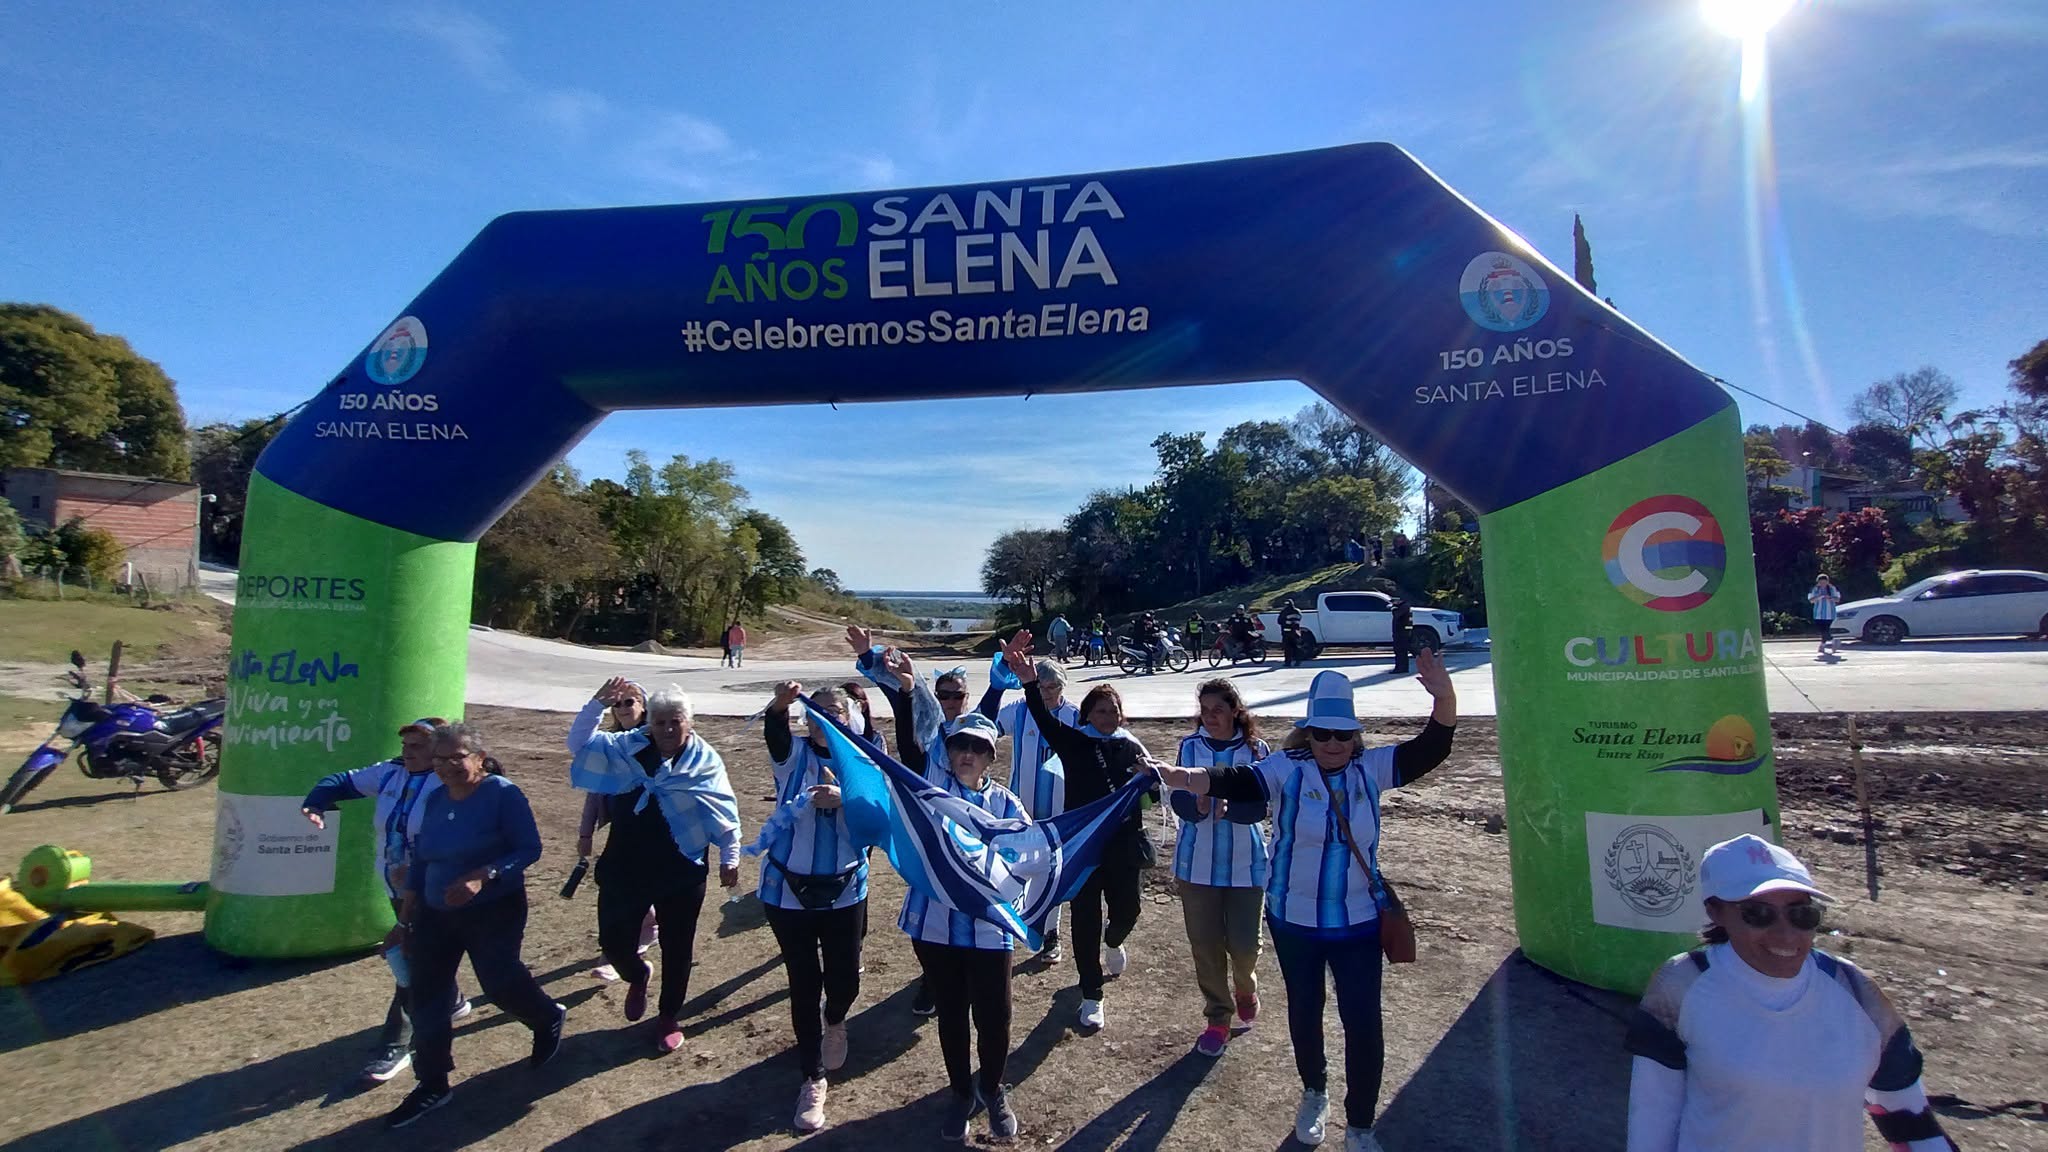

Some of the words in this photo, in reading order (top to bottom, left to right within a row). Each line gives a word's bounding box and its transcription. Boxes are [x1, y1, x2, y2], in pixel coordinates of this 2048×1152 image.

[867, 181, 1125, 236] SANTA
[869, 226, 1118, 300] ELENA
[706, 252, 849, 305] AÑOS
[682, 302, 1149, 353] #CelebremosSantaElena
[1439, 347, 1484, 371] 150
[1491, 336, 1574, 365] AÑOS
[1415, 380, 1505, 404] SANTA
[1512, 368, 1607, 397] ELENA
[339, 393, 368, 410] 150
[372, 389, 439, 412] AÑOS
[315, 421, 383, 439] SANTA
[388, 423, 469, 441] ELENA
[237, 575, 366, 601] DEPORTES
[1564, 628, 1757, 668] CULTURA
[1566, 669, 1679, 681] MUNICIPALIDAD
[1683, 668, 1701, 679] DE
[1703, 666, 1739, 678] SANTA
[298, 699, 312, 719] y
[318, 698, 338, 708] en
[1572, 727, 1634, 746] Santa
[1642, 728, 1703, 745] Elena
[1589, 721, 1637, 730] TURISMO
[1597, 749, 1632, 759] Entre
[258, 844, 291, 855] Santa
[295, 844, 331, 854] Elena
